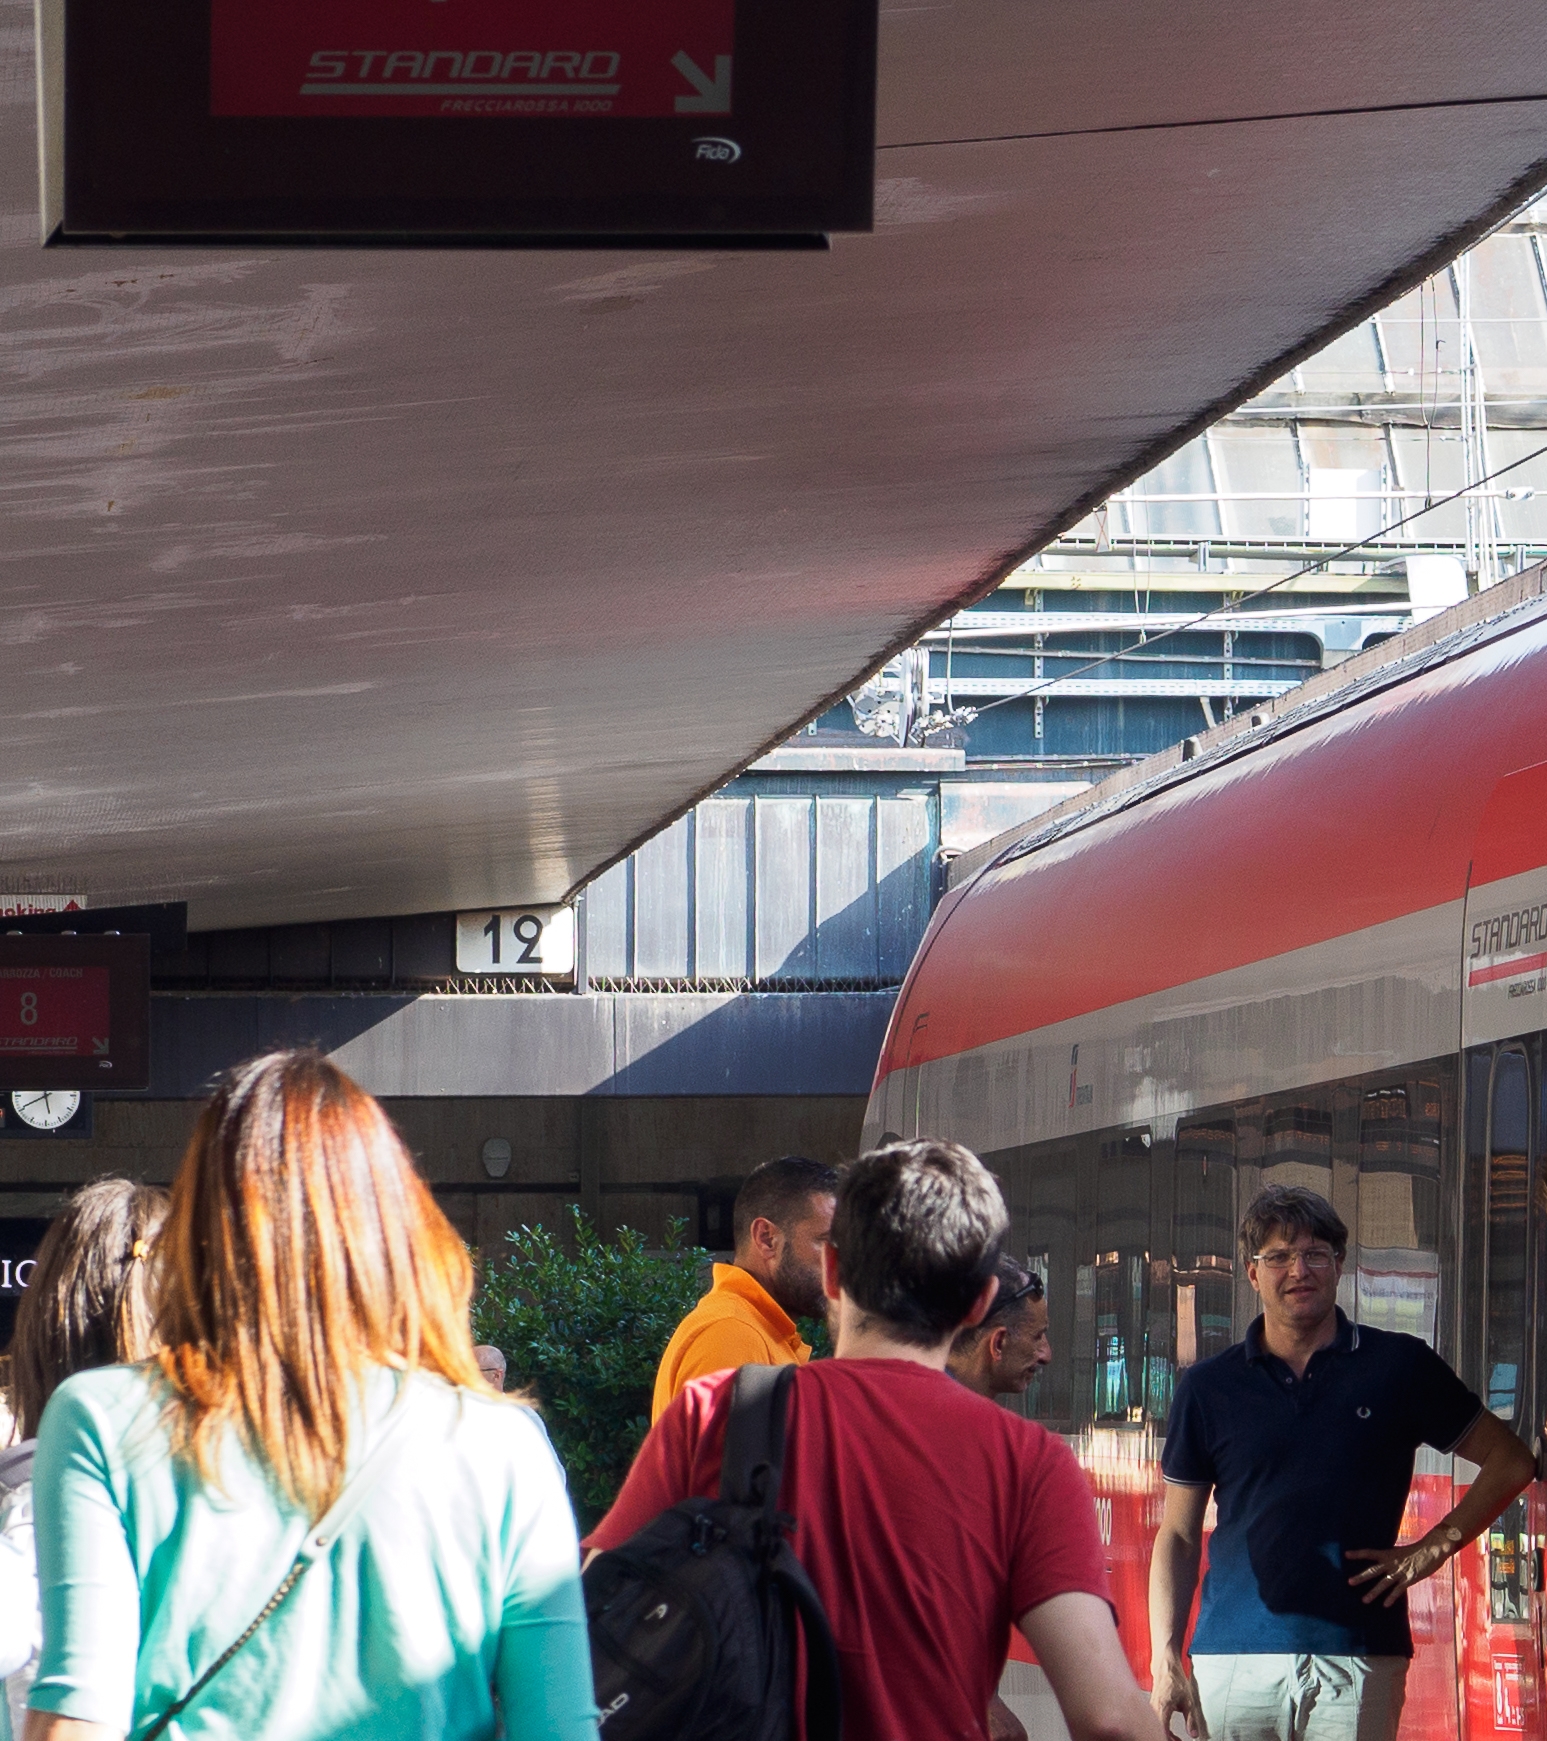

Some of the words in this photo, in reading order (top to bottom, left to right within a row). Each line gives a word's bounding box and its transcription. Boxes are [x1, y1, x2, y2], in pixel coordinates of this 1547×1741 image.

[305, 50, 622, 79] STANDARD
[441, 99, 570, 112] FRECCIAROSSA
[573, 99, 615, 112] 1000
[483, 914, 544, 964] 12
[49, 967, 84, 979] COACH
[20, 991, 38, 1026] 8
